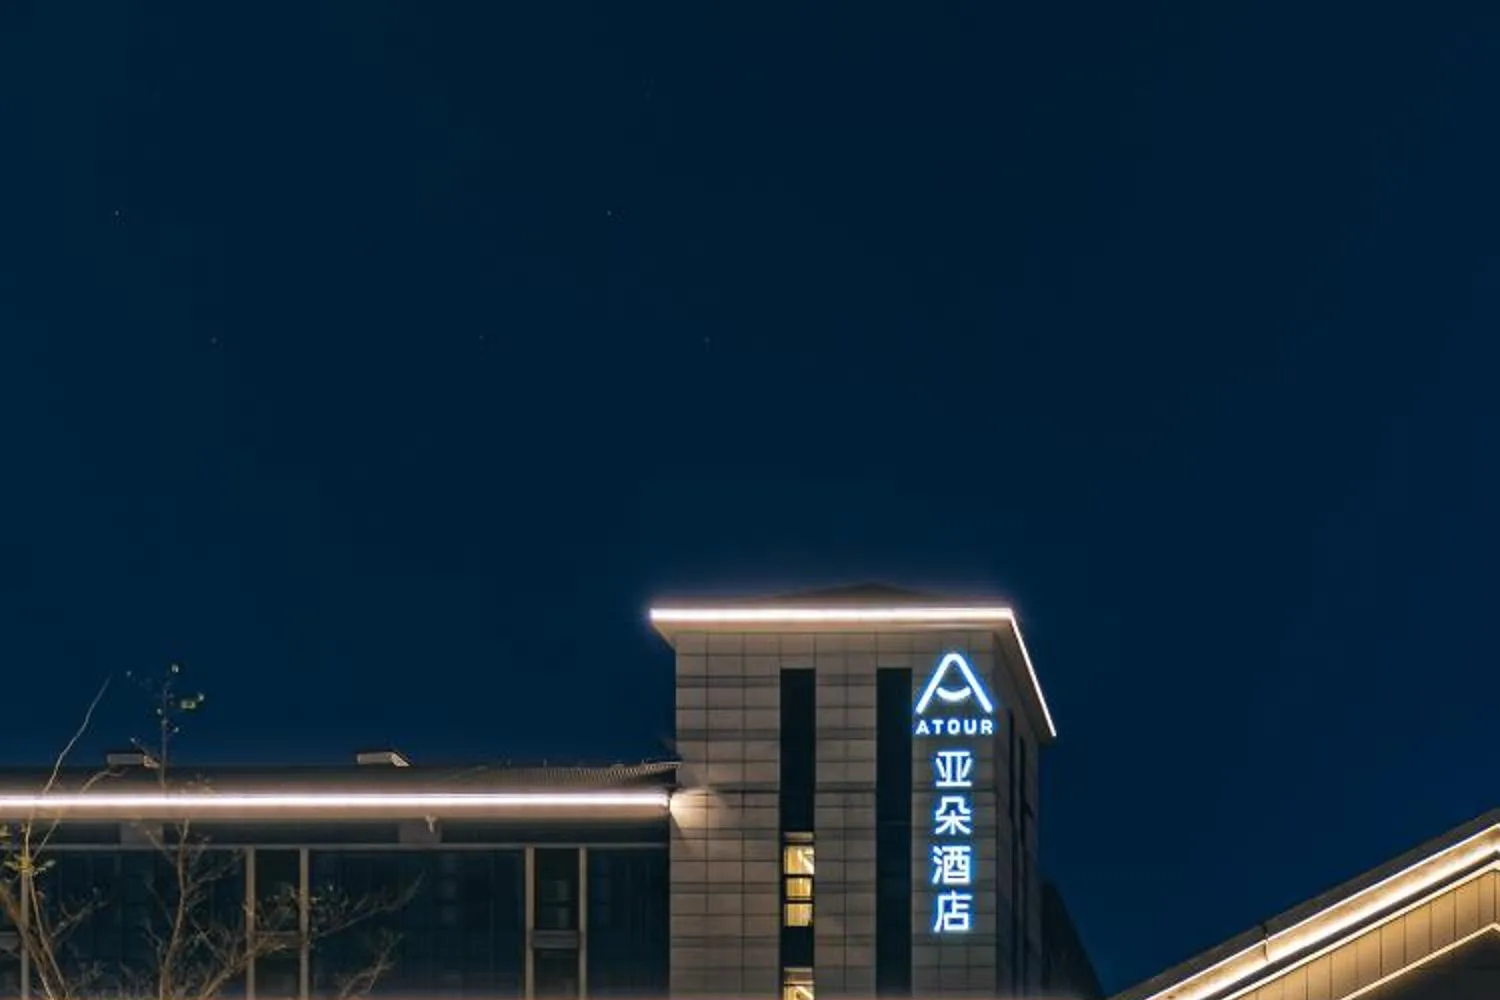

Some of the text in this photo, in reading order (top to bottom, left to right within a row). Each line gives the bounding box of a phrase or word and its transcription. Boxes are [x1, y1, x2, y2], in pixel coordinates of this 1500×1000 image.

[915, 719, 993, 735] ATOUR
[931, 751, 974, 933] 亚朵酒店
